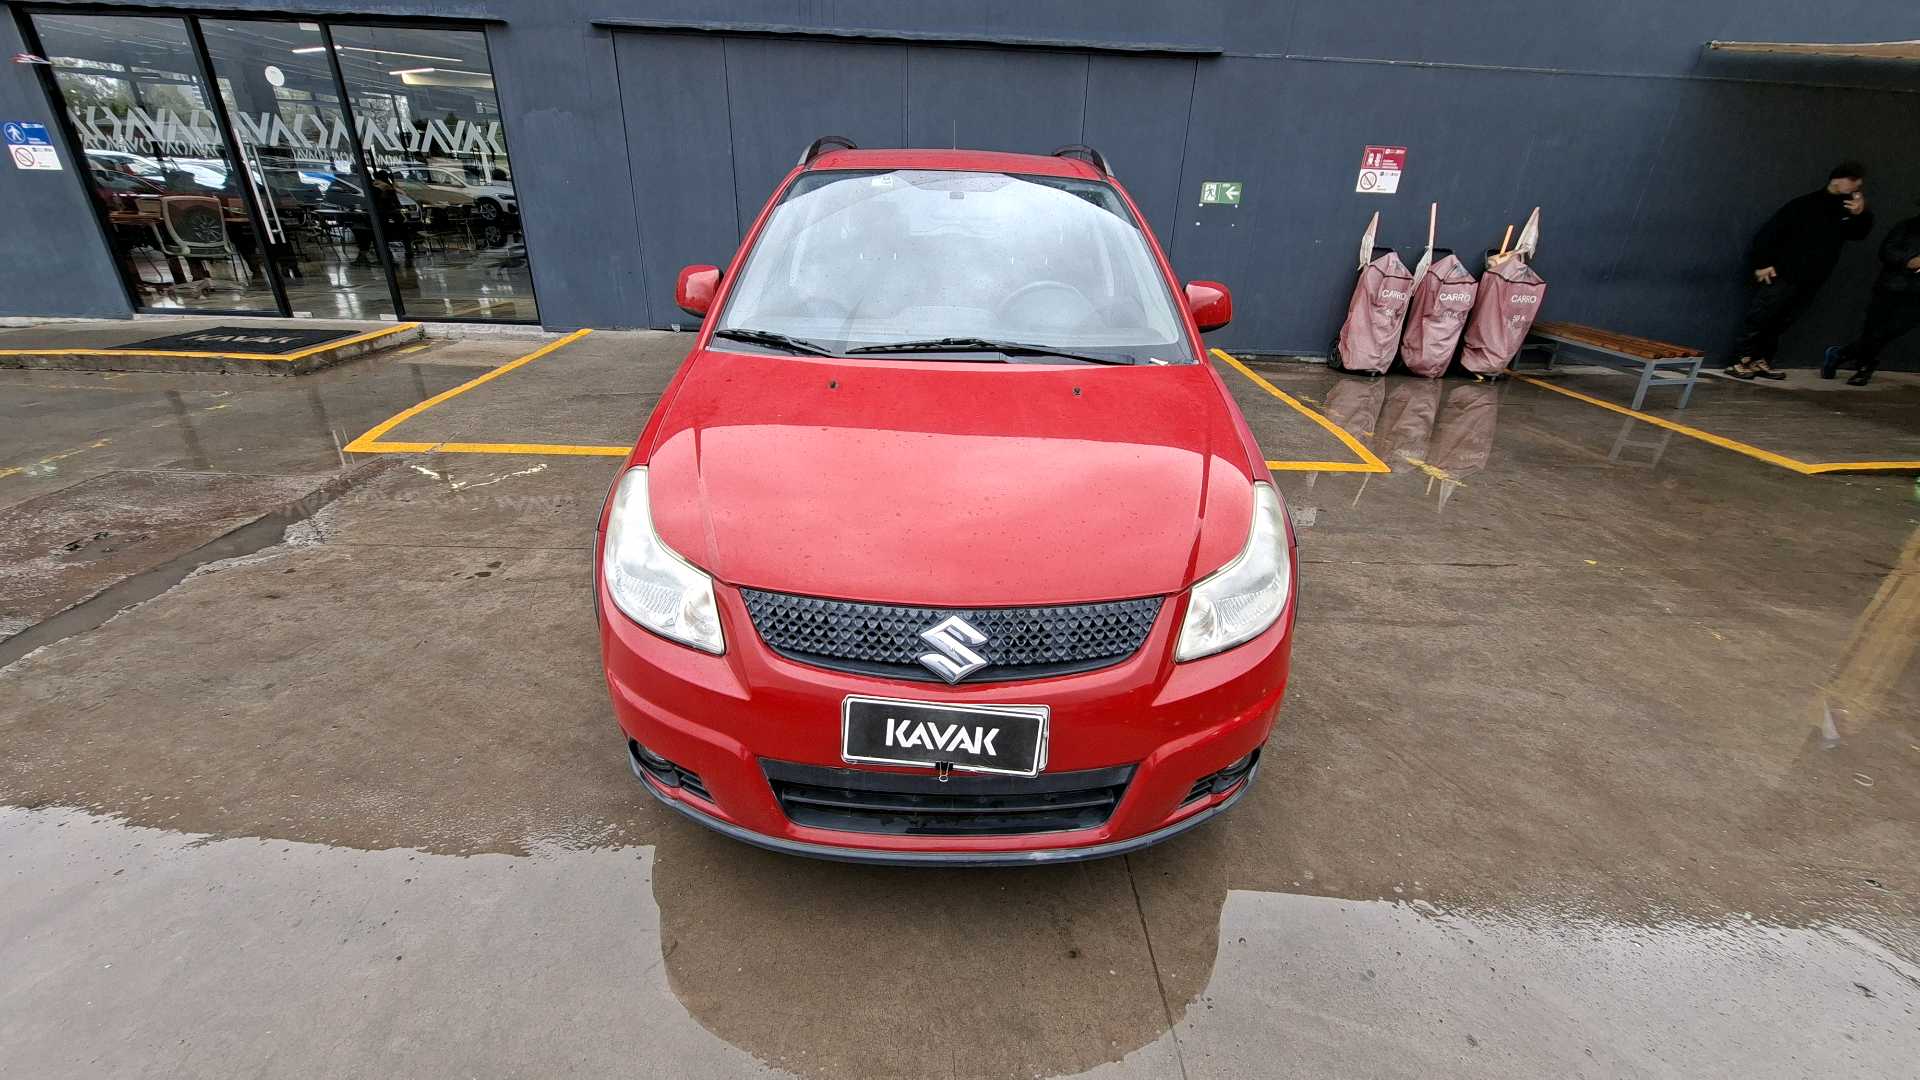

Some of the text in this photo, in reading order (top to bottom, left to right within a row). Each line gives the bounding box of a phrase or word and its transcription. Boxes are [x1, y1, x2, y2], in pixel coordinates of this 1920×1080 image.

[1382, 289, 1407, 301] CARRO
[1439, 293, 1471, 302] CARRO
[1511, 294, 1537, 303] CARRO
[885, 718, 1000, 756] KAVAK
